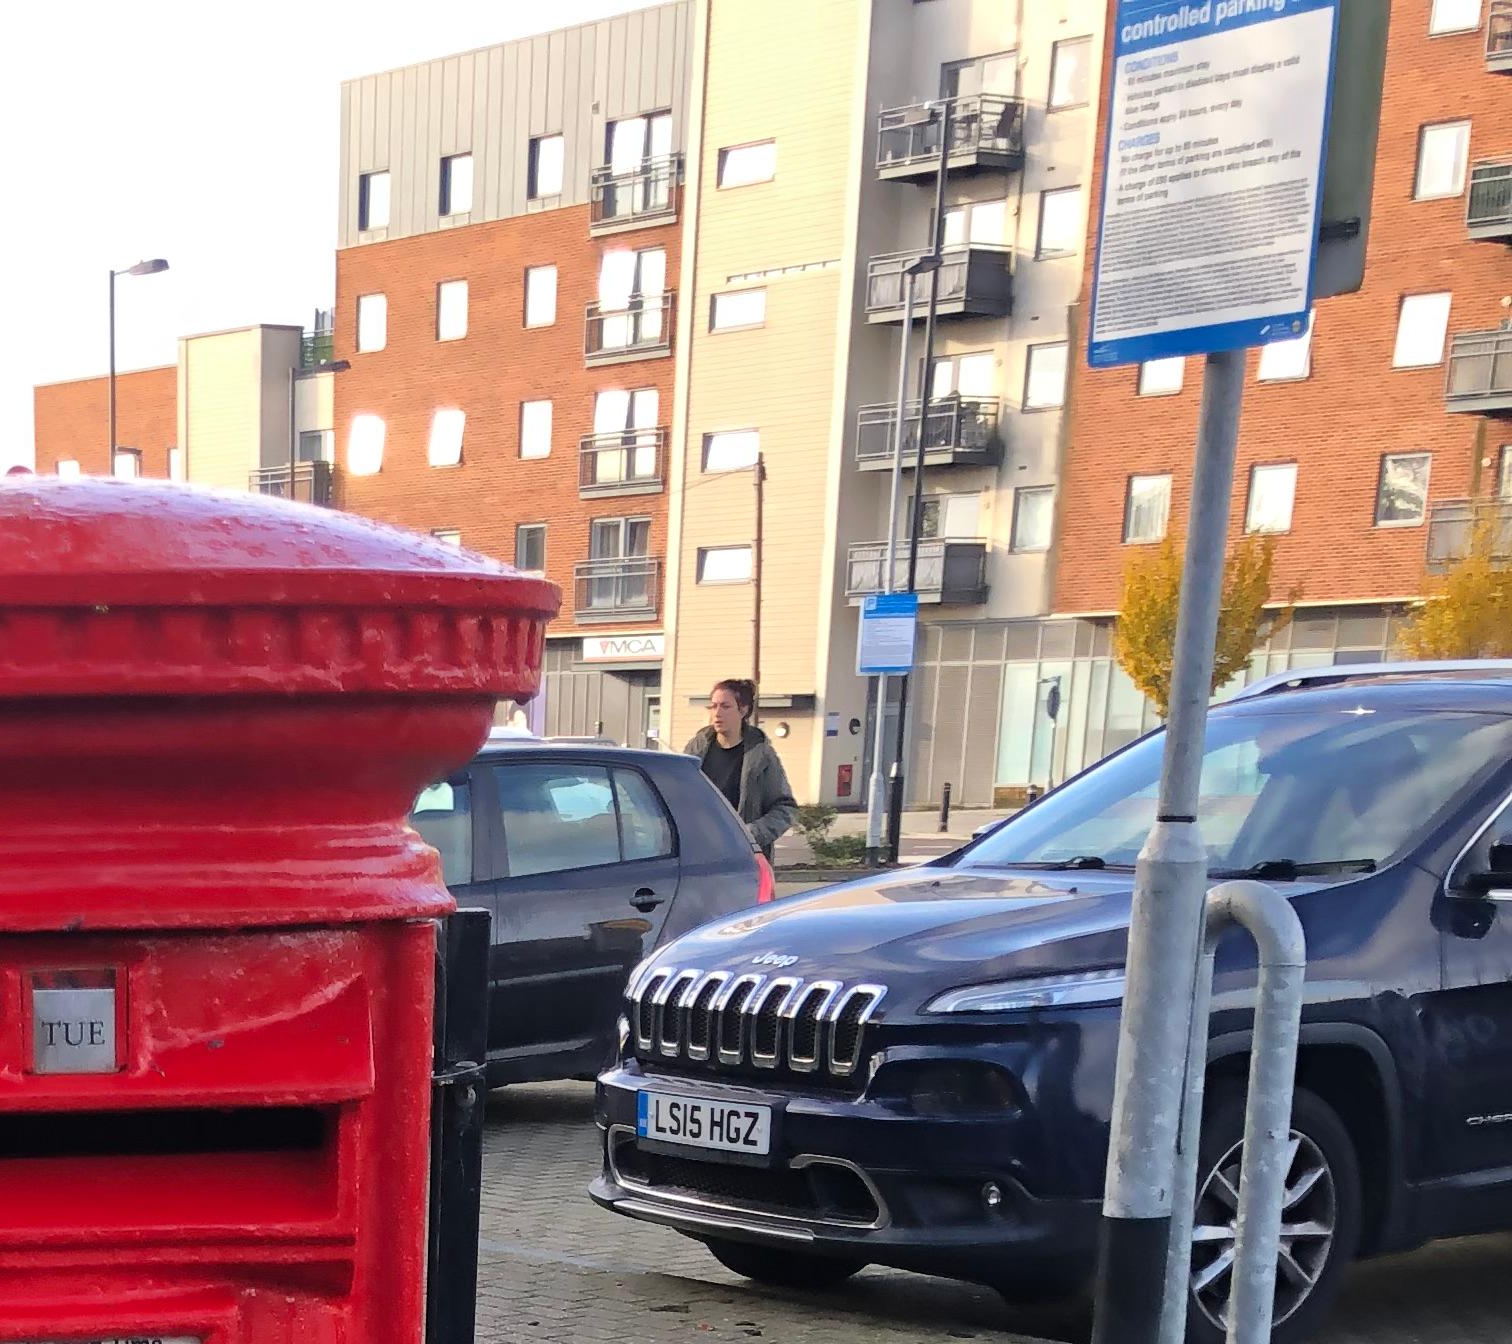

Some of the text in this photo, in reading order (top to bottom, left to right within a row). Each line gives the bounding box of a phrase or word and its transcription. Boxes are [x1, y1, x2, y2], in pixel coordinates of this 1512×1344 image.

[1120, 0, 1211, 43] controlled
[599, 639, 657, 654] YMCA
[751, 951, 799, 968] Jeep
[40, 1020, 106, 1047] TUE
[655, 1099, 760, 1147] LS15 HGZ
